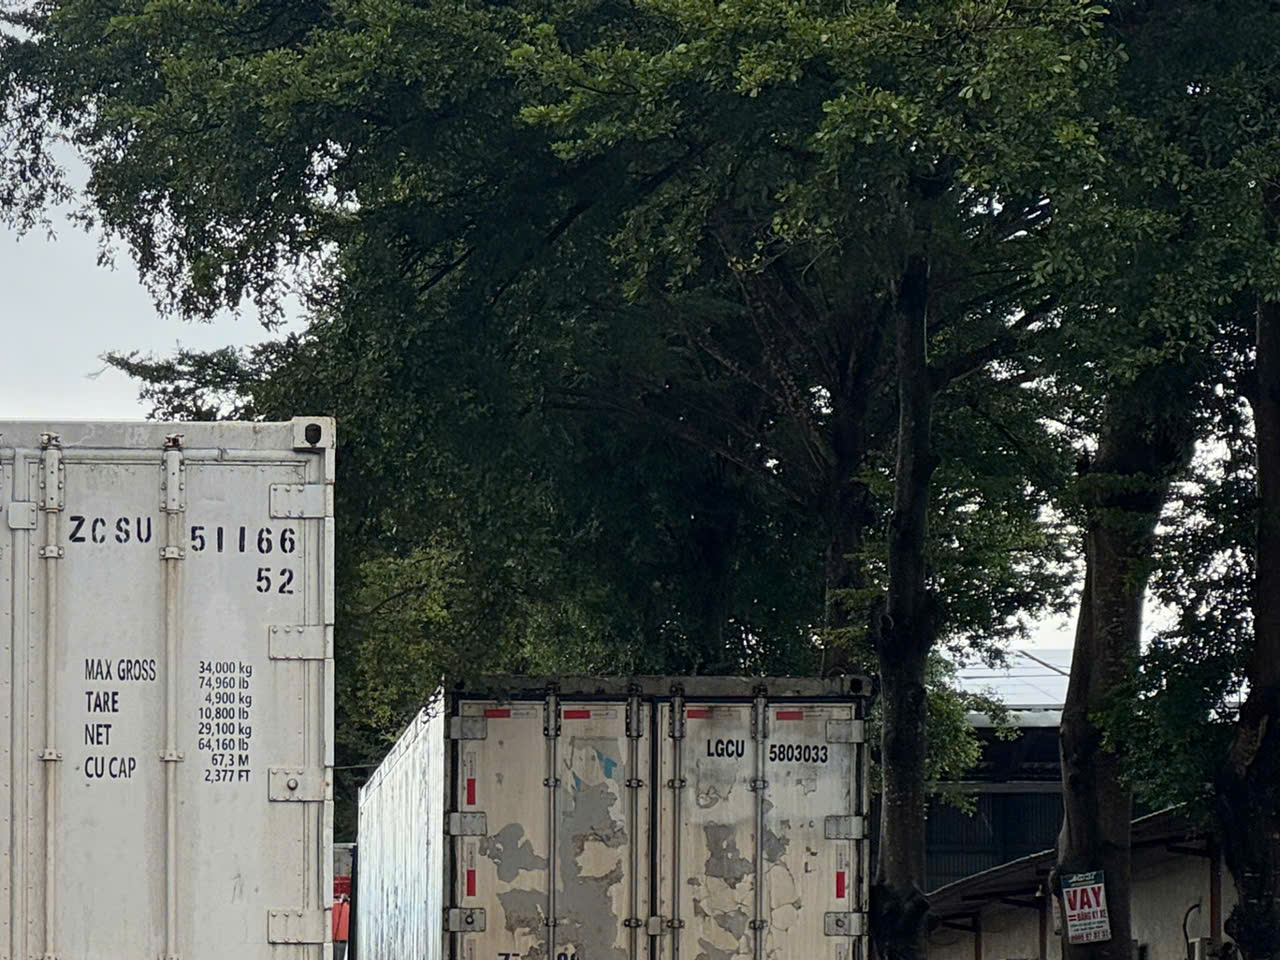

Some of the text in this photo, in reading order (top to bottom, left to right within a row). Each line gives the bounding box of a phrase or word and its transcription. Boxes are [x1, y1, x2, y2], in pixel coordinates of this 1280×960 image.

[68, 515, 296, 554] ZCSU 51166
[255, 567, 295, 595] 52
[85, 658, 157, 681] MAX GROSS
[198, 661, 253, 677] 34,000 kg
[198, 676, 249, 692] 74,960 lb
[85, 691, 120, 713] TARE
[204, 692, 253, 708] 4,900 kg
[198, 707, 249, 722] 10,800 lb
[84, 723, 113, 746] NET
[197, 722, 252, 738] 29,100 kg
[197, 738, 249, 753] 64,160 lb
[706, 739, 829, 763] LGCU 5803033
[84, 756, 137, 779] CU CAP
[238, 754, 249, 766] M
[204, 769, 251, 784] 2,377 FT
[1065, 886, 1102, 911] VAY
